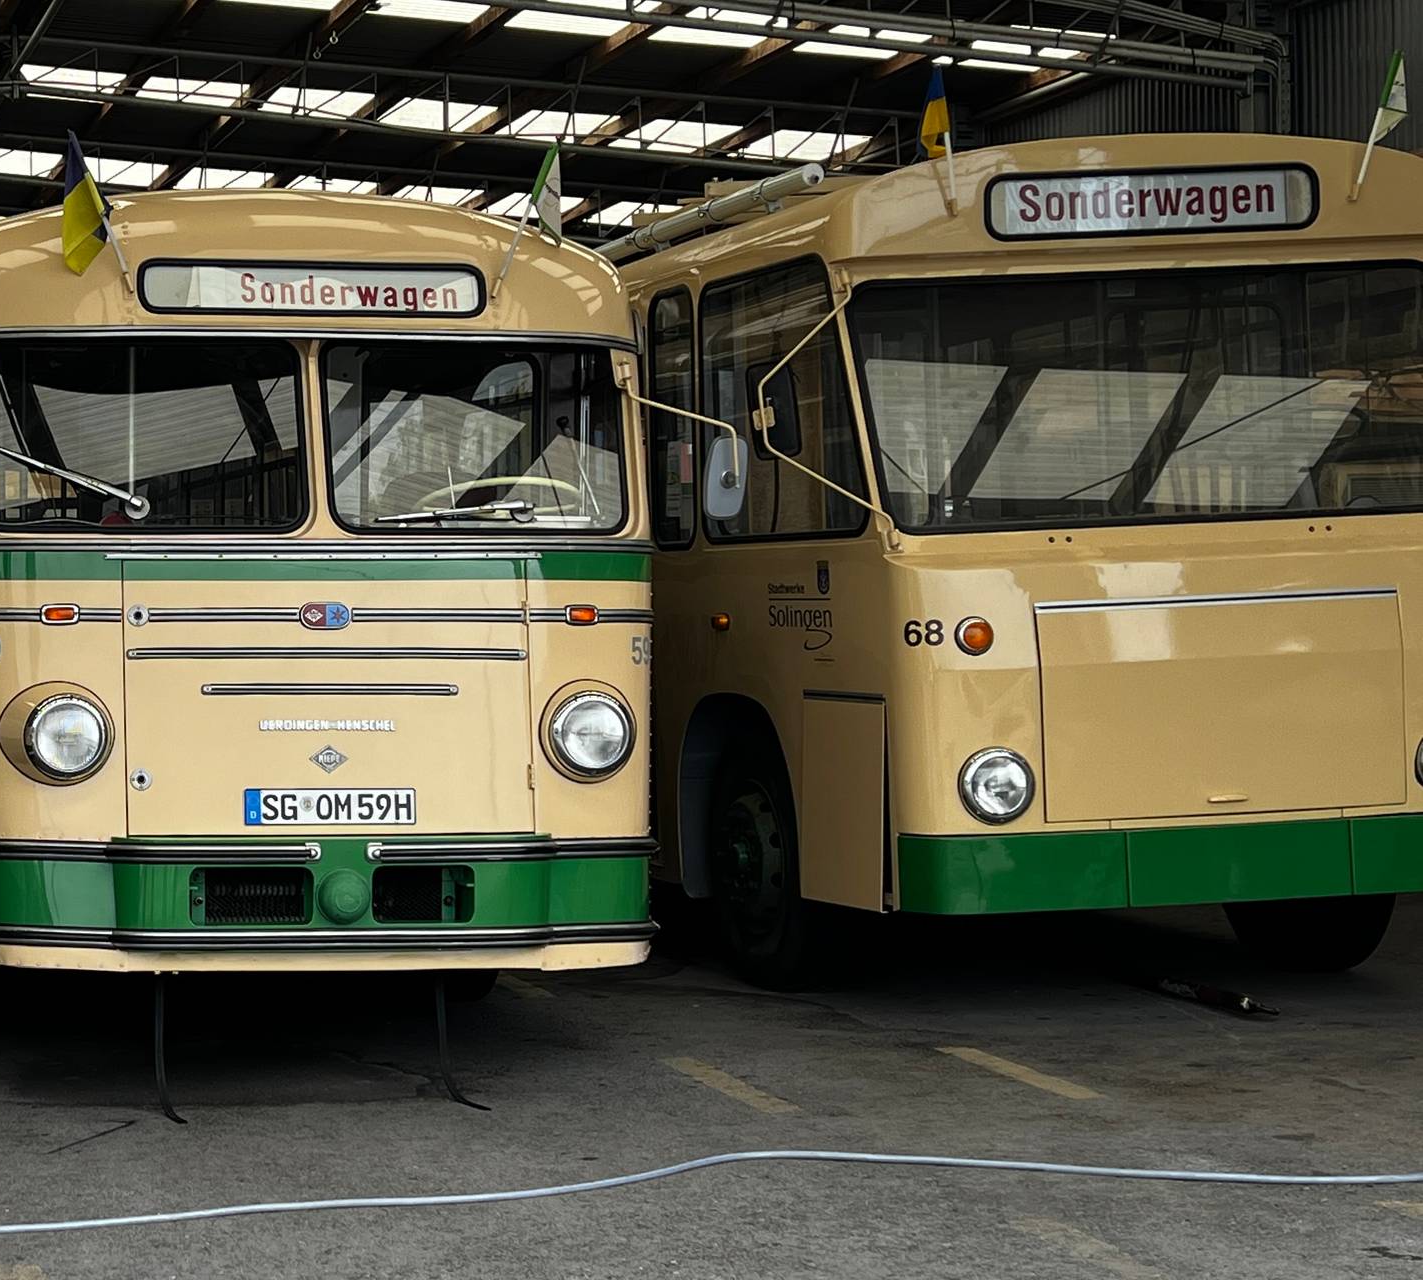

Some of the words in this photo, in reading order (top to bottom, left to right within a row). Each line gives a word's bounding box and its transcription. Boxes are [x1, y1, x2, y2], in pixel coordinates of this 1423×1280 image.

[1019, 182, 1275, 223] Sonderwagen
[240, 272, 458, 310] Sonderwagen
[768, 605, 833, 650] Solingen
[904, 619, 944, 647] 68
[250, 811, 257, 819] D
[262, 794, 298, 820] SG
[316, 794, 352, 820] OM
[358, 794, 412, 820] 59H
